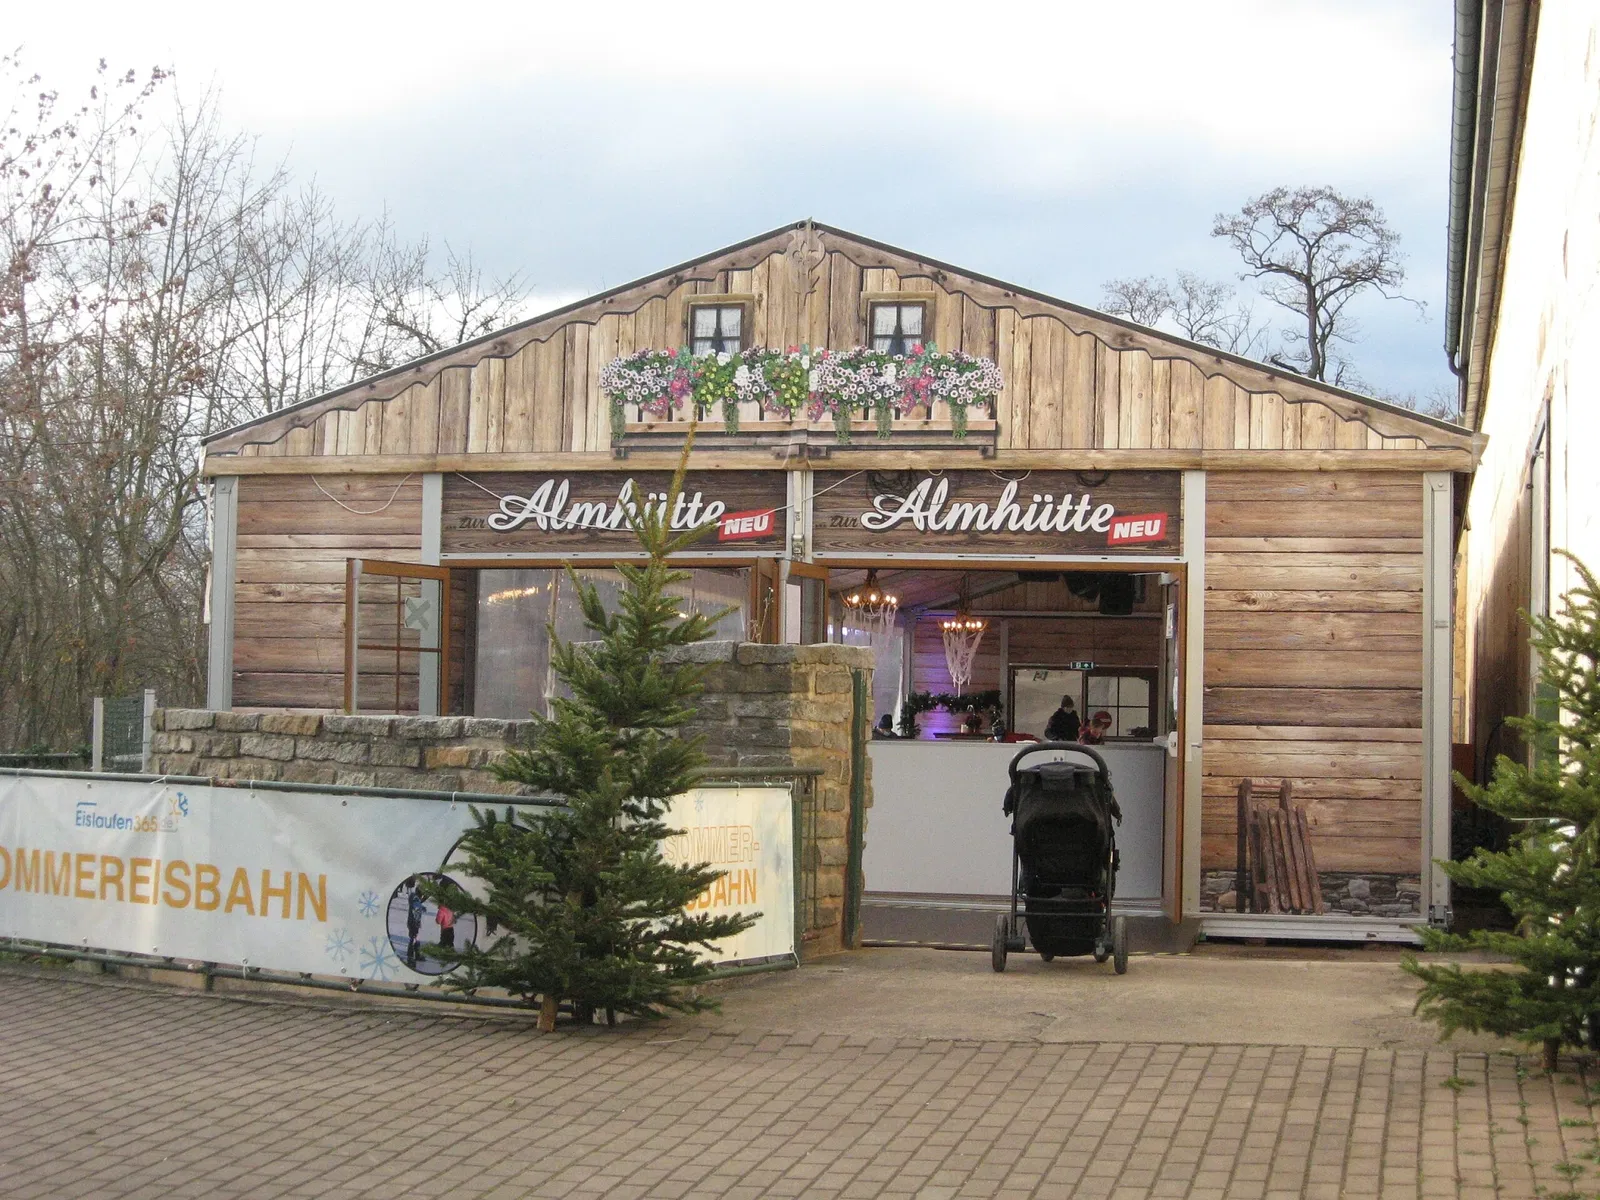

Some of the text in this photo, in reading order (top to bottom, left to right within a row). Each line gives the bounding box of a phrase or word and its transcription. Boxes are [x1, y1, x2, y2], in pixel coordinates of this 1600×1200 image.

[487, 477, 726, 531] Almhütte
[723, 514, 770, 535] NEU
[860, 477, 1115, 532] Almhütte
[1112, 518, 1161, 540] NEU
